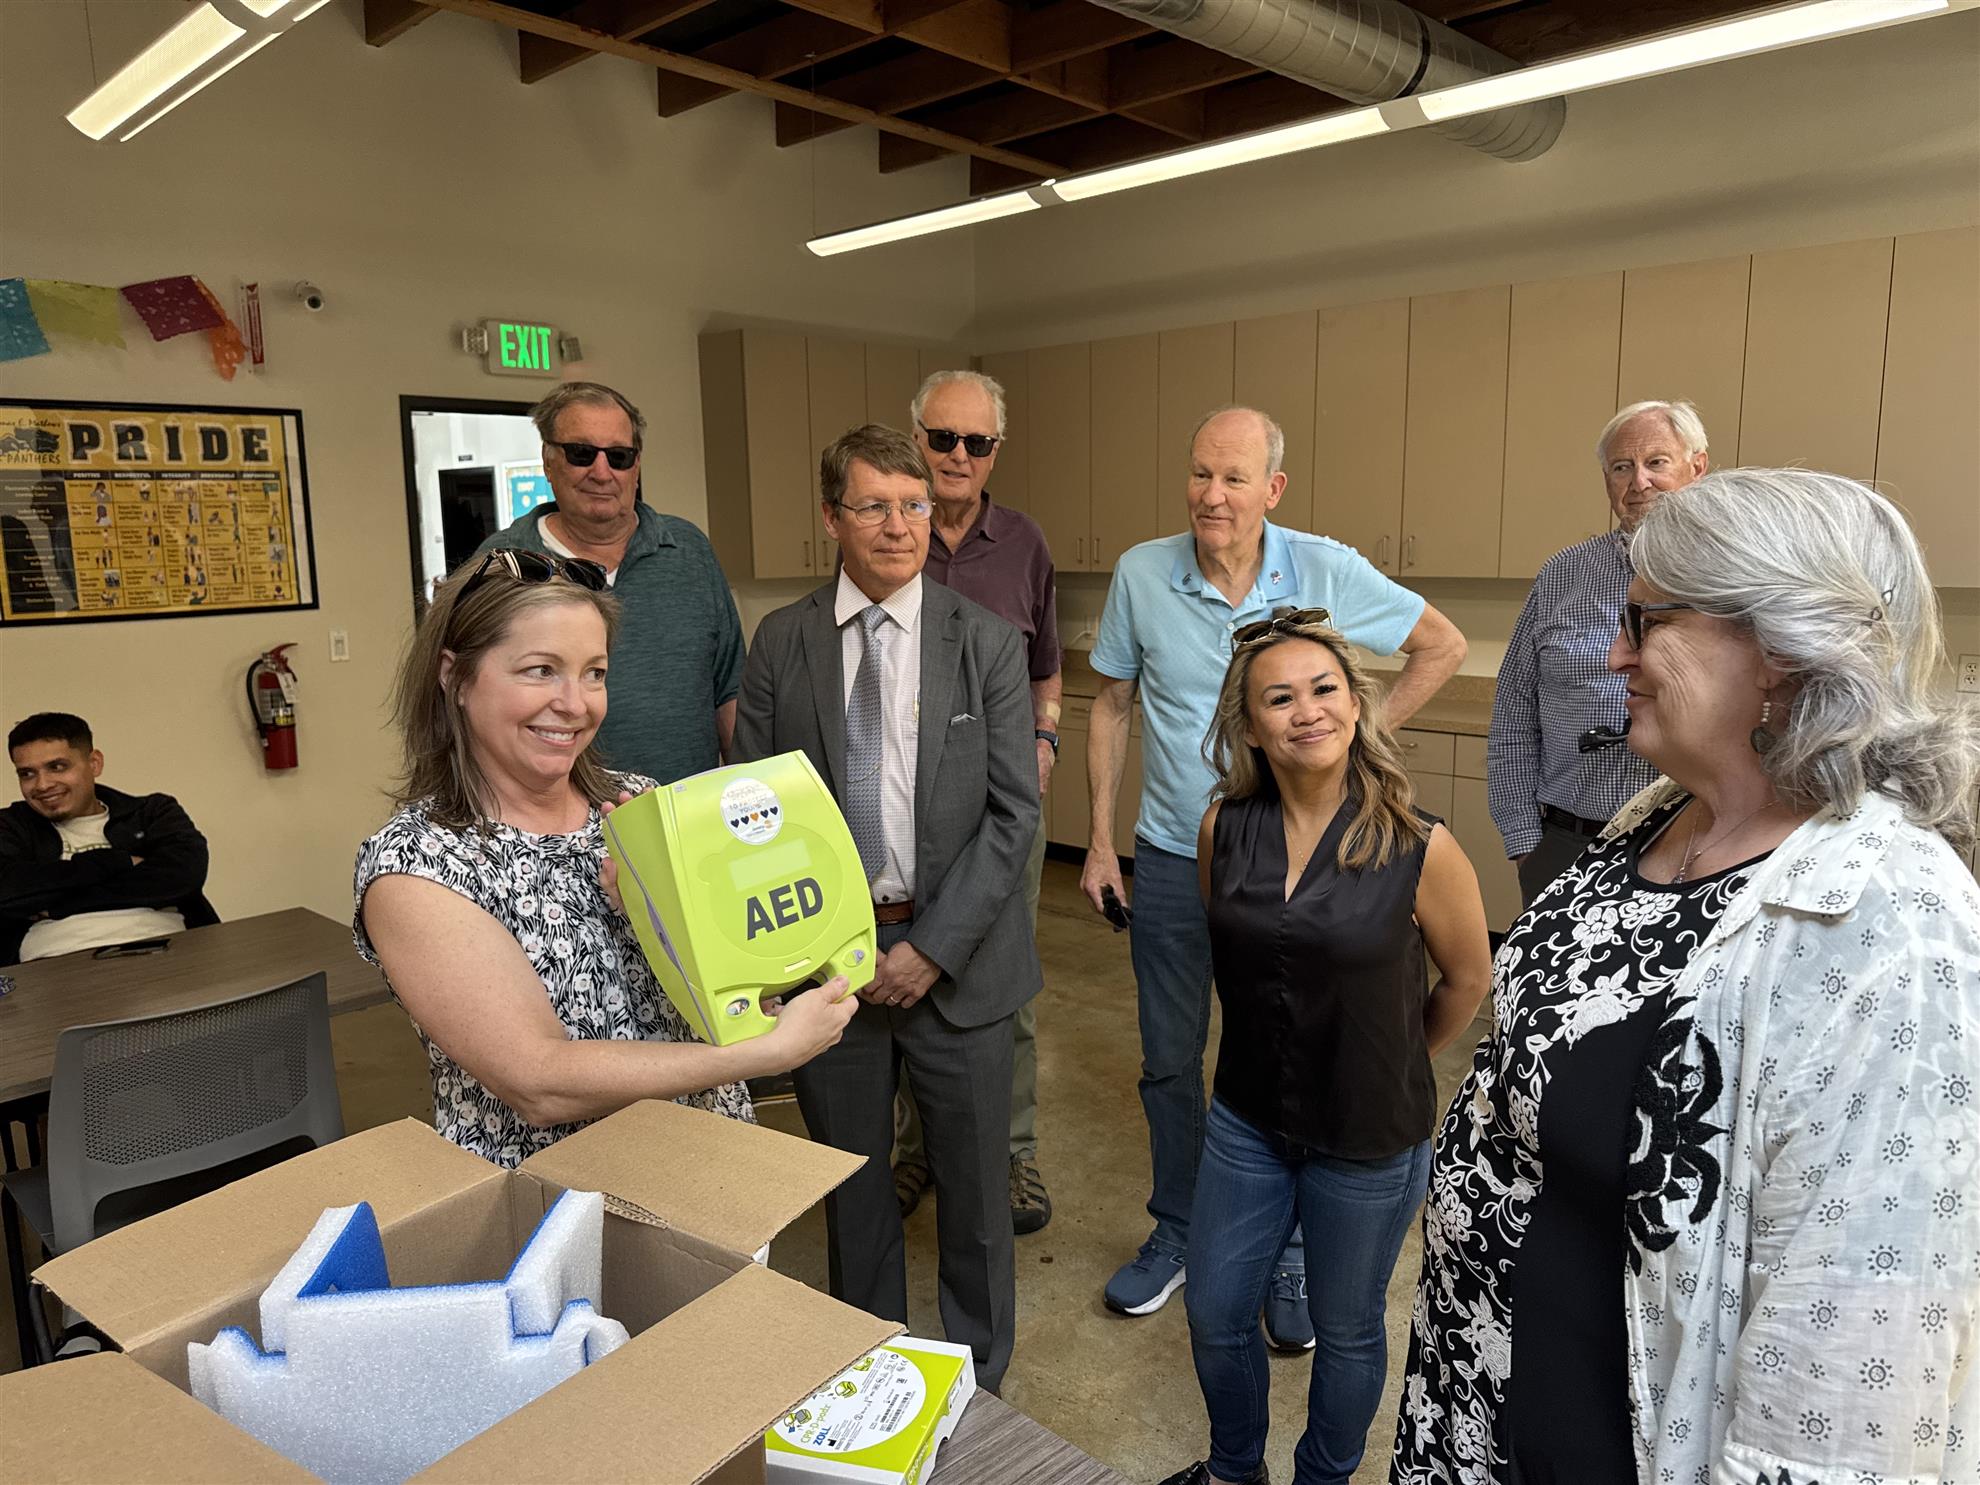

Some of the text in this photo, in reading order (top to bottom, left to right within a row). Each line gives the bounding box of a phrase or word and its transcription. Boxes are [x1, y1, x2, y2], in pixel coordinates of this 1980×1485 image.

[500, 323, 552, 370] EXIT
[7, 451, 61, 465] PANTHERS
[66, 420, 271, 464] PRIDE
[746, 877, 824, 941] AED
[812, 1425, 833, 1446] ZOLL
